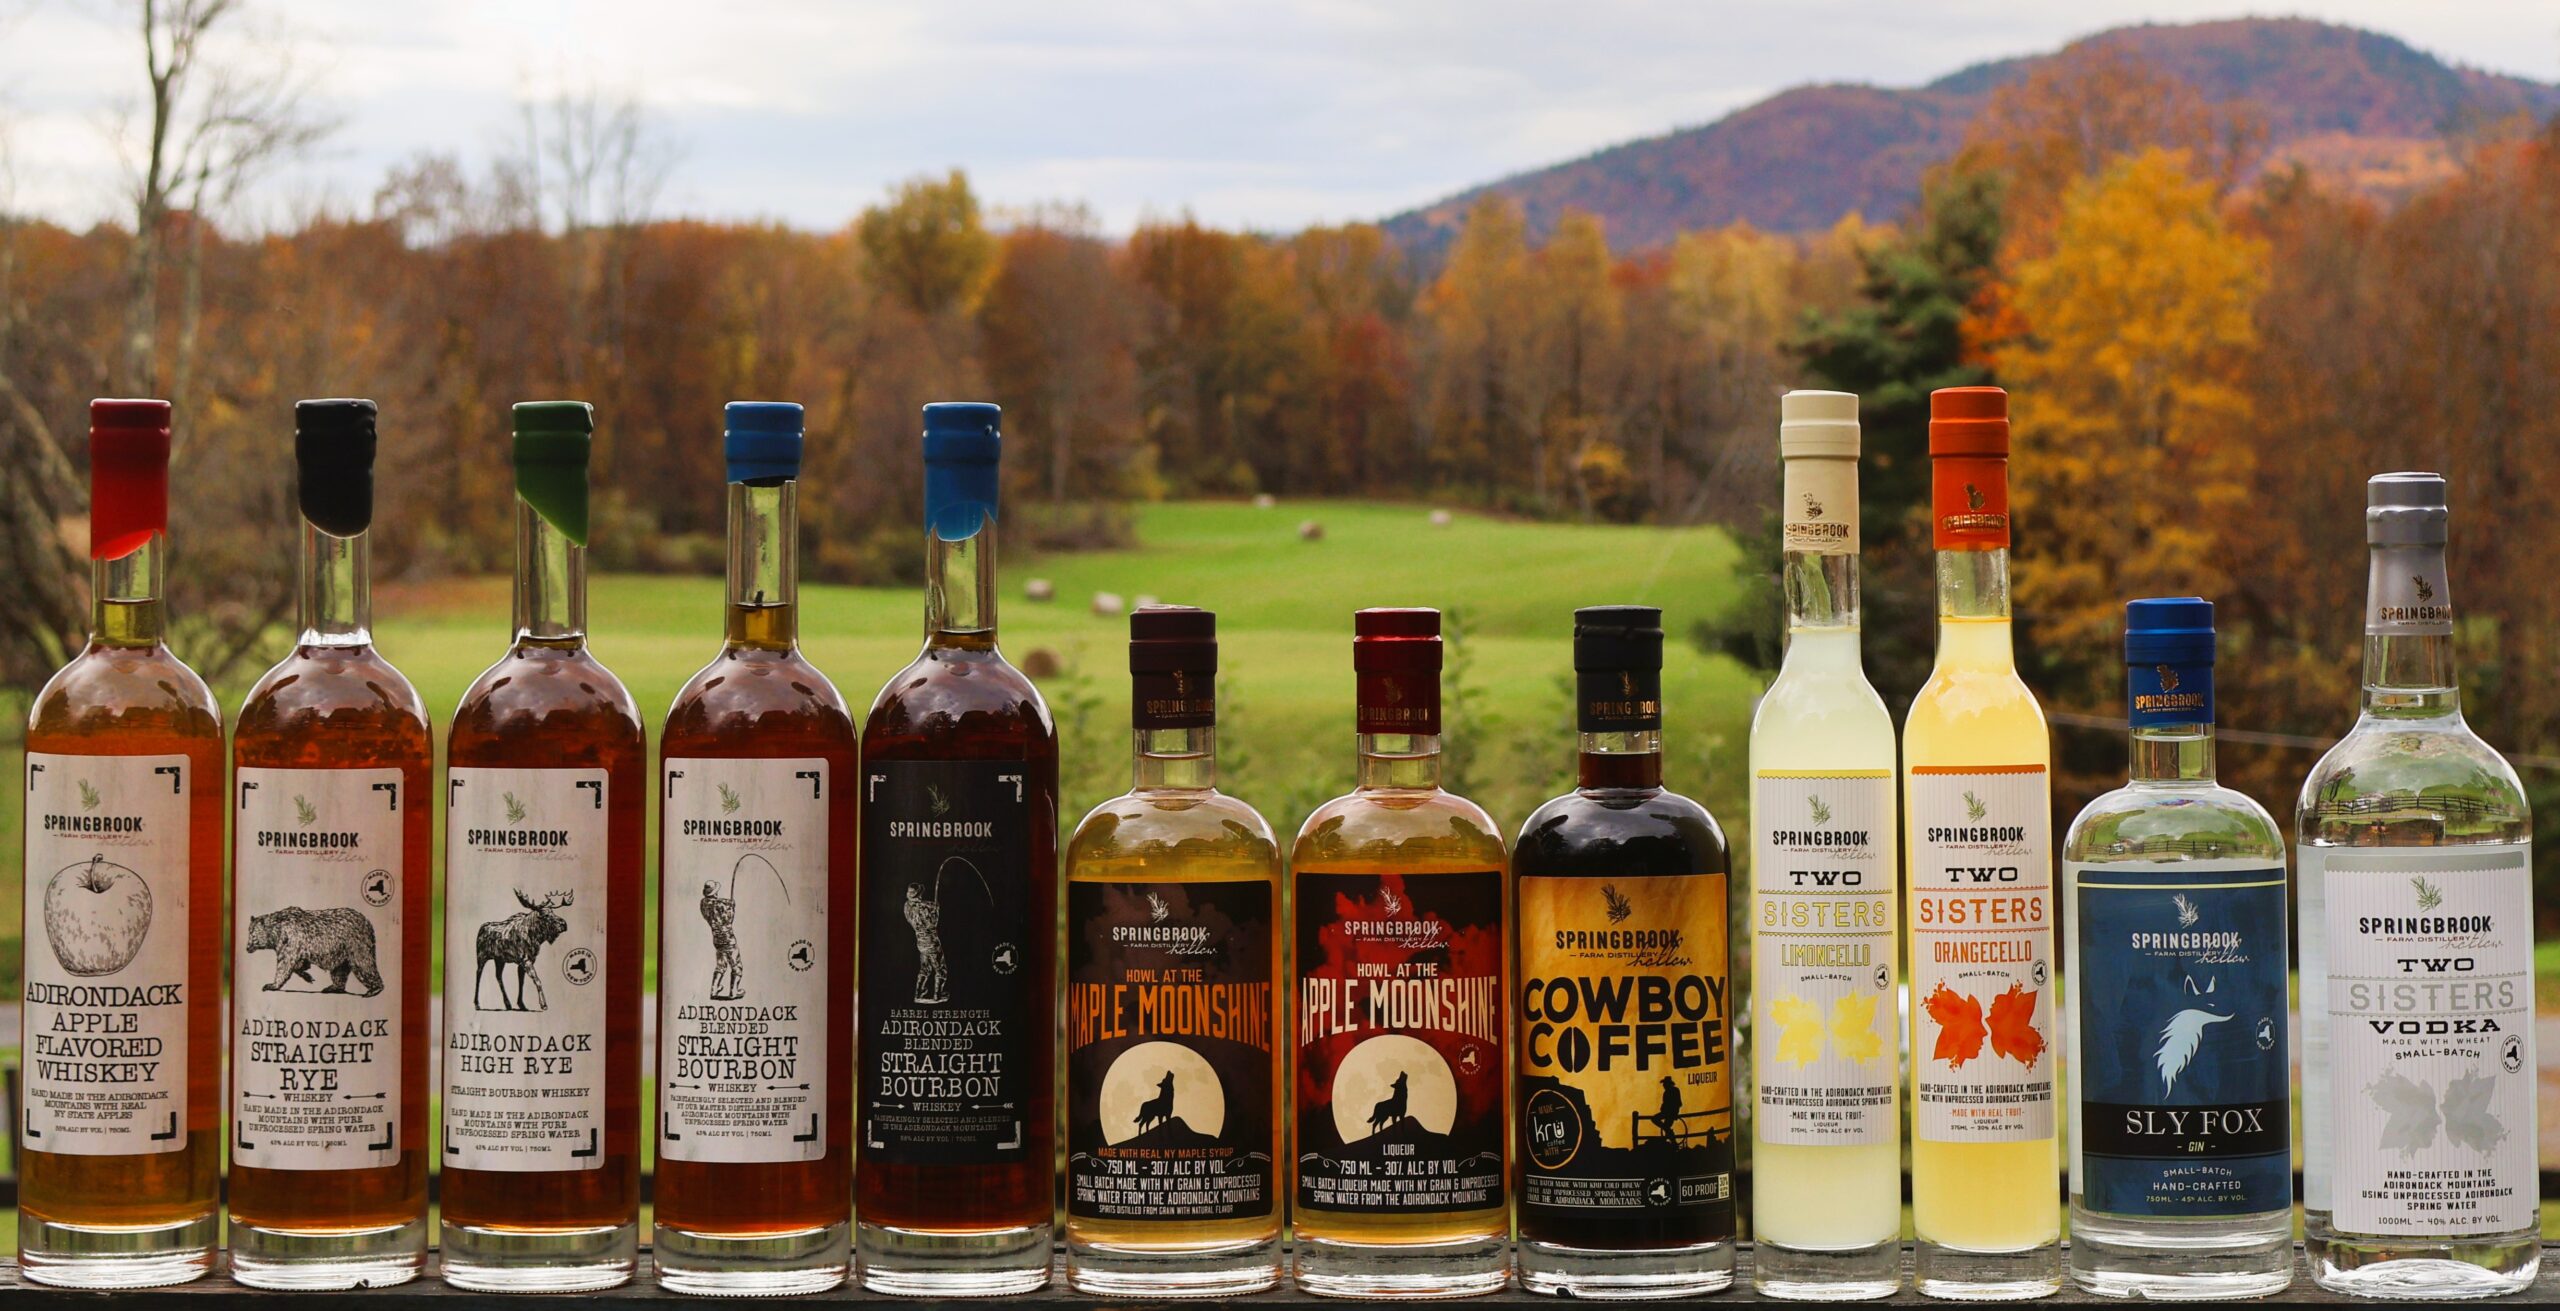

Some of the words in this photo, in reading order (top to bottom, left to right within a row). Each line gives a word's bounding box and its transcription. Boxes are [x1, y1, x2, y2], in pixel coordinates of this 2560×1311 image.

[44, 815, 143, 832] SPRINGBROOK
[684, 820, 782, 835] SPRINGBROOK
[890, 821, 992, 838] SPRINGBROOK
[258, 831, 359, 848] SPRINGBROOK
[468, 829, 568, 846] SPRINGBROOK
[1773, 830, 1868, 845] SPRINGBROOK
[1928, 827, 2024, 842] SPRINGBROOK
[1790, 871, 1861, 885] TWO
[1945, 867, 2018, 882] TWO
[1764, 901, 1885, 927] SISTERS
[1920, 897, 2042, 924] SISTERS
[1345, 921, 1439, 935] SPRINGBROOK
[2359, 915, 2491, 934] SPRINGBROOK
[1112, 926, 1207, 941] SPRINGBROOK
[1556, 930, 1680, 949] SPRINGBROOK
[2132, 932, 2239, 949] SPRINGBROOK
[1782, 944, 1870, 966] LIMONCELLO
[1935, 940, 2032, 963] ORANGECELLO
[1357, 963, 1391, 977] HOWL
[1397, 963, 1410, 977] AT
[1416, 963, 1438, 976] THE
[2397, 958, 2474, 972] TWO
[1126, 969, 1158, 983] HOWL
[1163, 969, 1176, 983] AT
[1182, 969, 1202, 982] THE
[1801, 974, 1852, 982] SMALL-BATCH
[1959, 970, 2010, 978] SMALL-BATCH
[26, 981, 183, 1007] ADIRONDACK
[1523, 975, 1726, 1024] COWBOY
[2350, 981, 2514, 1011] SISTERS
[678, 1005, 797, 1021] ADIRONDACK
[891, 1009, 929, 1019] BARREL
[932, 1010, 989, 1019] STRENGTH
[1071, 982, 1127, 1053] MAPLE
[1138, 982, 1270, 1053] MOONSHINE
[1302, 977, 1358, 1047] APPLE
[1370, 975, 1497, 1045] MOONSHINE
[51, 1012, 138, 1033] APPLE
[241, 1019, 389, 1039] ADIRONDACK
[700, 1023, 768, 1035] BLENDED
[881, 1020, 1001, 1036] ADIRONDACK
[2369, 1019, 2501, 1034] VODKA
[36, 1034, 162, 1057] FLAVORED
[450, 1032, 592, 1052] ADIRONDACK
[678, 1035, 798, 1057] STRAIGHT
[904, 1038, 973, 1050] BLENDED
[1528, 1020, 1725, 1073] COFFEE
[251, 1041, 374, 1063] STRAIGHT
[2395, 1049, 2480, 1060] SMALL-BATCH
[461, 1055, 514, 1074] HIGH
[524, 1057, 572, 1074] RYE
[678, 1058, 796, 1080] BOURBON
[881, 1052, 1002, 1074] STRAIGHT
[37, 1059, 159, 1082] WHISKEY
[280, 1068, 338, 1090] RYE
[1688, 1072, 1718, 1086] LIQUEUR
[489, 1088, 538, 1098] BOURBON
[542, 1087, 590, 1097] WHISKEY
[708, 1083, 757, 1092] WHISKEY
[881, 1076, 1000, 1097] BOURBON
[87, 1092, 106, 1100] THE
[109, 1091, 168, 1101] ADIRONDACK
[283, 1093, 334, 1102] WHISKEY
[94, 1102, 118, 1110] WITH
[120, 1102, 146, 1110] REAL
[264, 1105, 288, 1114] MADE
[303, 1107, 321, 1115] THE
[324, 1105, 384, 1115] ADIRONDACK
[912, 1102, 962, 1112] WHISKEY
[67, 1111, 95, 1119] STATE
[258, 1116, 309, 1124] MOUNTAINS
[338, 1116, 363, 1124] PURE
[529, 1110, 589, 1119] ADIRONDACK
[2126, 1111, 2190, 1135] SLY
[2200, 1108, 2264, 1135] FOX
[308, 1125, 342, 1133] SPRING
[345, 1124, 376, 1132] WATER
[464, 1119, 512, 1129] MOUNTAINS
[514, 1121, 538, 1129] WITH
[541, 1121, 567, 1129] PURE
[511, 1131, 545, 1139] SPRING
[1140, 1149, 1161, 1158] REAL
[1179, 1148, 1206, 1158] MAPLE
[1383, 1144, 1415, 1156] LIQUEUR
[2188, 1141, 2204, 1152] GIN
[1107, 1160, 1122, 1174] 750
[1126, 1161, 1139, 1175] ML
[1174, 1161, 1191, 1175] ALC
[1194, 1160, 1206, 1174] BY
[1210, 1160, 1226, 1174] VOL
[1340, 1160, 1356, 1175] 750
[1359, 1161, 1372, 1175] ML
[1407, 1161, 1424, 1175] ALC
[1428, 1161, 1440, 1174] BY
[1443, 1160, 1458, 1174] VOL
[2163, 1167, 2232, 1177] SMALL-BATCH
[2388, 1171, 2460, 1179] HAND-CRAFTED
[2477, 1169, 2492, 1177] THE
[1095, 1177, 1114, 1189] BATCH
[1117, 1178, 1137, 1190] MADE
[1140, 1178, 1160, 1190] WITH
[1178, 1178, 1201, 1190] GRAIN
[1338, 1178, 1367, 1191] LIQUEUR
[1370, 1180, 1392, 1191] MADE
[1394, 1180, 1414, 1191] WITH
[1430, 1179, 1451, 1191] GRAIN
[1682, 1185, 1693, 1196] 60
[1695, 1183, 1717, 1195] PROOF
[2153, 1181, 2241, 1191] HAND-CRAFTED
[2384, 1181, 2442, 1190] ADIRONDACK
[2448, 1179, 2496, 1189] MOUNTAINS
[1098, 1190, 1120, 1203] WATER
[1123, 1191, 1145, 1204] FROM
[1148, 1192, 1164, 1204] THE
[1168, 1191, 1218, 1204] ADIRONDACK
[1361, 1193, 1382, 1205] FROM
[1403, 1192, 1449, 1205] ADIRONDACK
[2362, 1191, 2388, 1199] USING
[2393, 1191, 2461, 1200] UNPROCESSED
[2466, 1188, 2513, 1198] ADIRONDACK
[2407, 1202, 2442, 1210] SPRING
[2447, 1201, 2477, 1210] WATER
[2378, 1217, 2412, 1225] 1000ML
